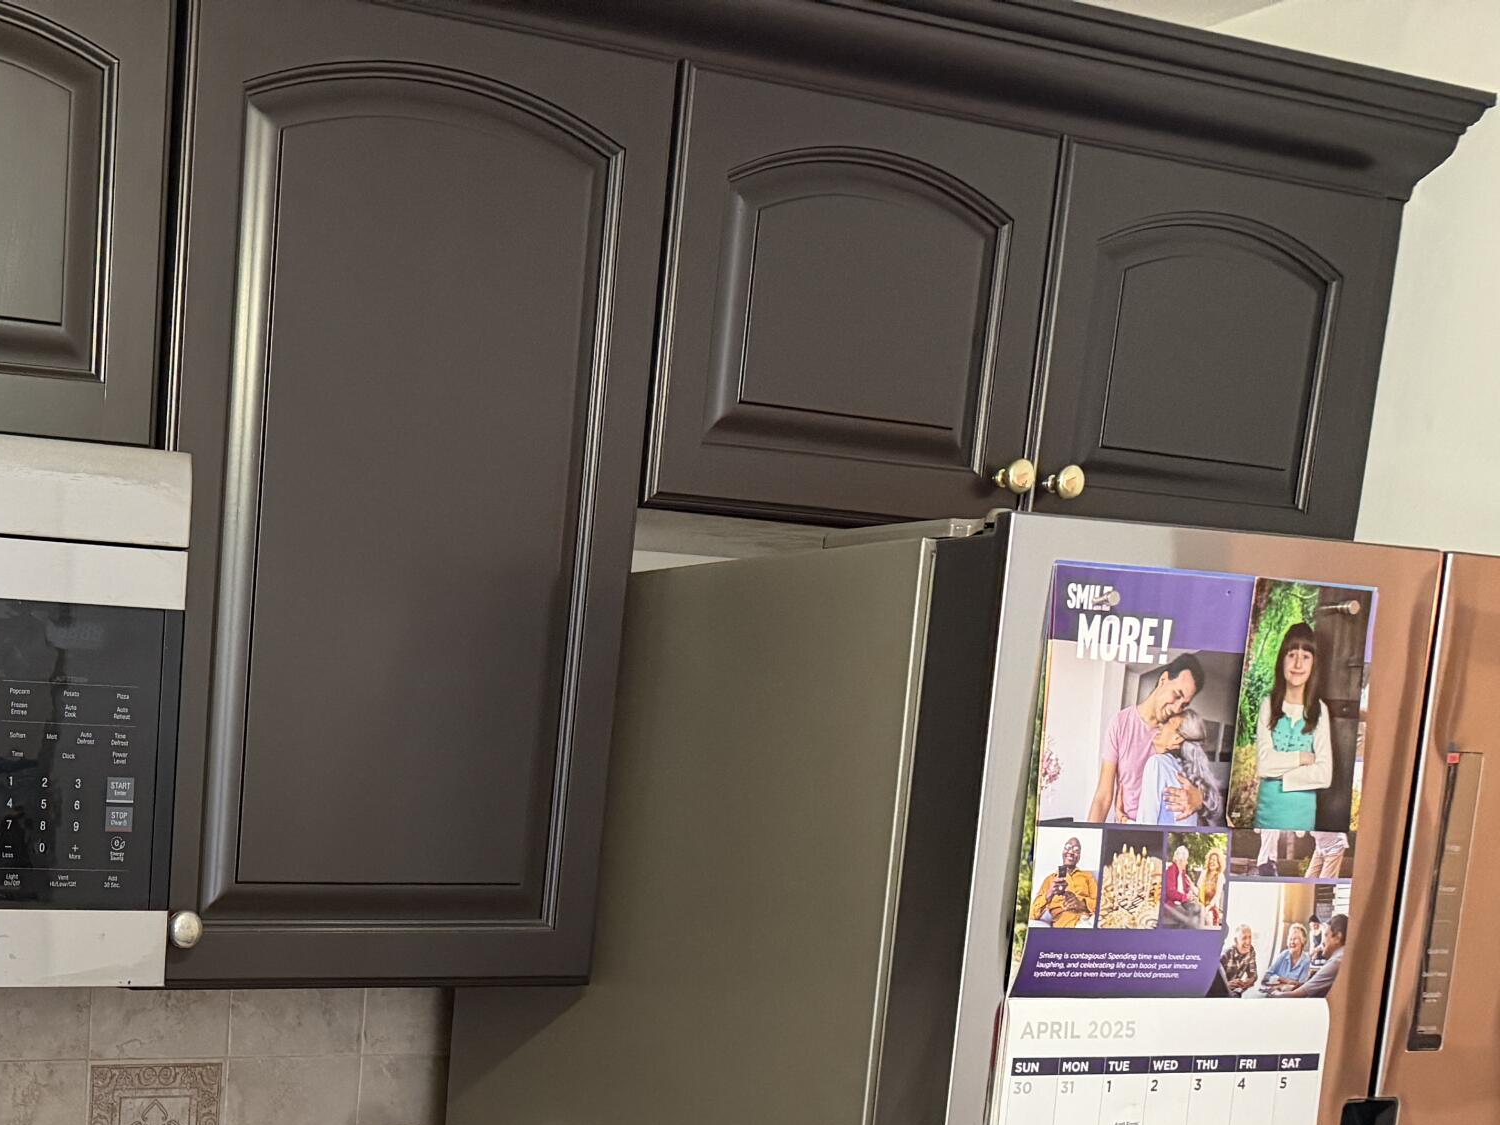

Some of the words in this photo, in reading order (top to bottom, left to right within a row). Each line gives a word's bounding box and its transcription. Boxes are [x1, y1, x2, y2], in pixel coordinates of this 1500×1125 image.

[1077, 614, 1172, 664] MORE!
[9, 776, 13, 786] 1
[42, 777, 48, 788] 2
[75, 778, 81, 789] 3
[6, 798, 13, 808] 4
[41, 799, 47, 809] 5
[74, 800, 80, 810] 6
[6, 820, 12, 829] 7
[40, 821, 46, 830] 8
[73, 822, 79, 832] 9
[39, 842, 45, 852] 0
[1039, 952, 1063, 960] Smiling
[1063, 952, 1069, 960] is
[1108, 953, 1137, 961] Spending
[1080, 962, 1115, 970] celebrating
[1033, 970, 1056, 978] system
[1118, 971, 1133, 979] your
[1020, 1021, 1080, 1040] APRIL
[1087, 1020, 1136, 1039] 2025
[1014, 1062, 1039, 1073] SUN
[1062, 1061, 1089, 1072] MON
[1108, 1061, 1130, 1072] TUE
[1153, 1060, 1179, 1070] WED
[1196, 1059, 1219, 1070] THU
[1239, 1059, 1257, 1069] FRI
[1281, 1058, 1301, 1068] SAT
[1013, 1082, 1032, 1094] 30
[1061, 1081, 1074, 1094] 31
[1107, 1080, 1111, 1092] 1
[1150, 1080, 1158, 1091] 2
[1194, 1078, 1202, 1091] 3
[1237, 1078, 1245, 1090] 4
[1280, 1077, 1287, 1089] 5
